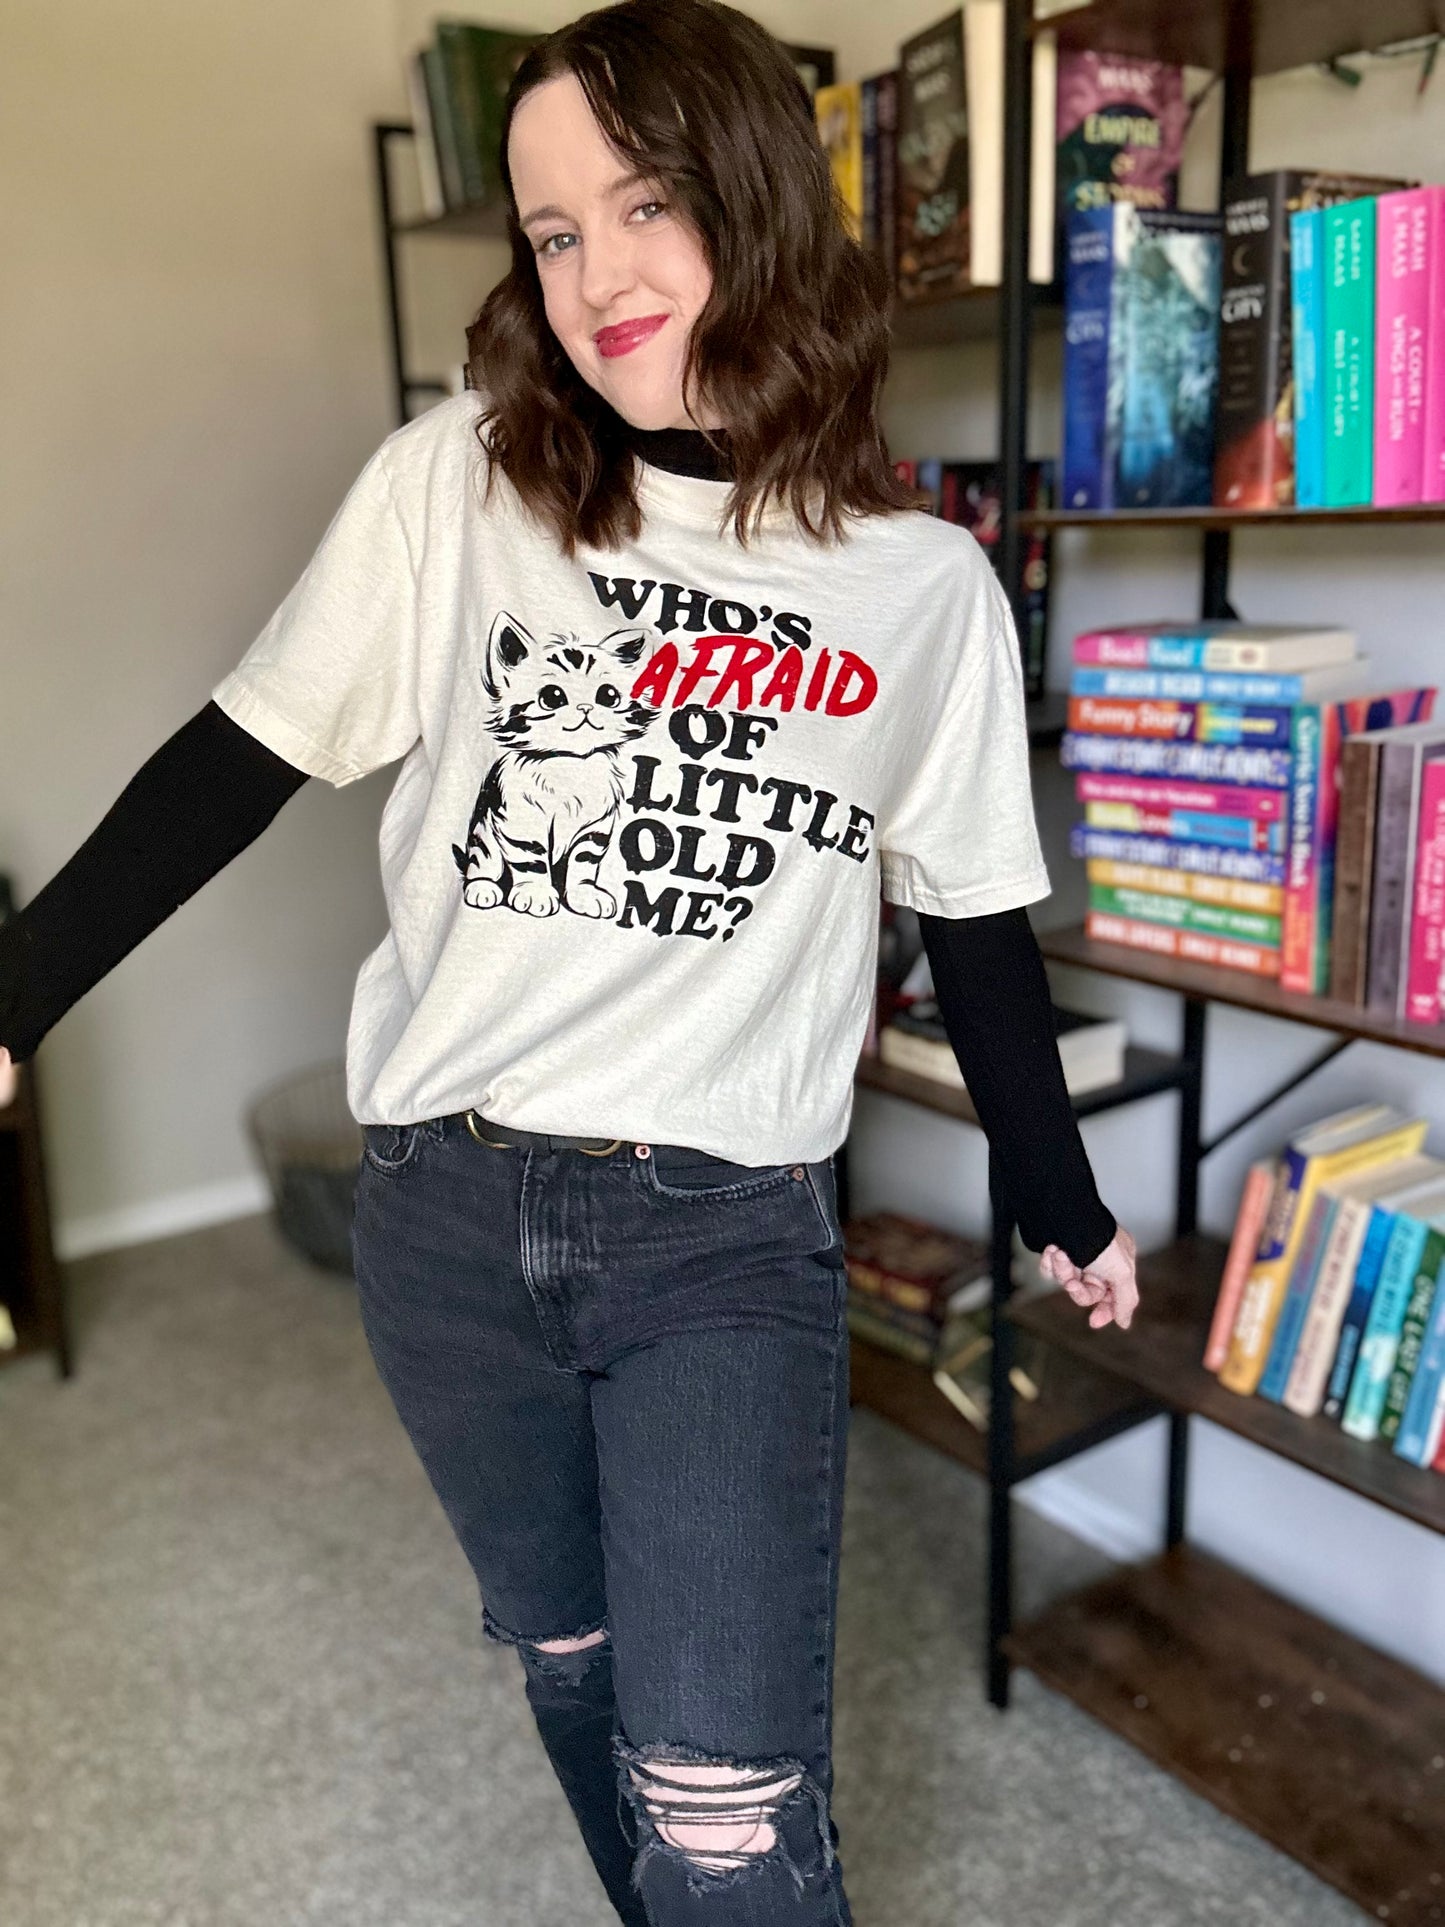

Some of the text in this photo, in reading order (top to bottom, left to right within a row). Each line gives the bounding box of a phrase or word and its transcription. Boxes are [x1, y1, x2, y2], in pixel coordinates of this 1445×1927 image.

[1392, 221, 1409, 279] MAAS
[1410, 205, 1427, 272] SARAH
[1407, 345, 1424, 408] COURT
[587, 572, 812, 652] WHO'S
[631, 635, 877, 716] AFRAID
[669, 704, 778, 760] OF
[1079, 699, 1135, 732] Funny
[1138, 702, 1193, 737] Story
[626, 755, 874, 863] LITTLE
[619, 819, 775, 891] OLD
[616, 880, 753, 942] ME?
